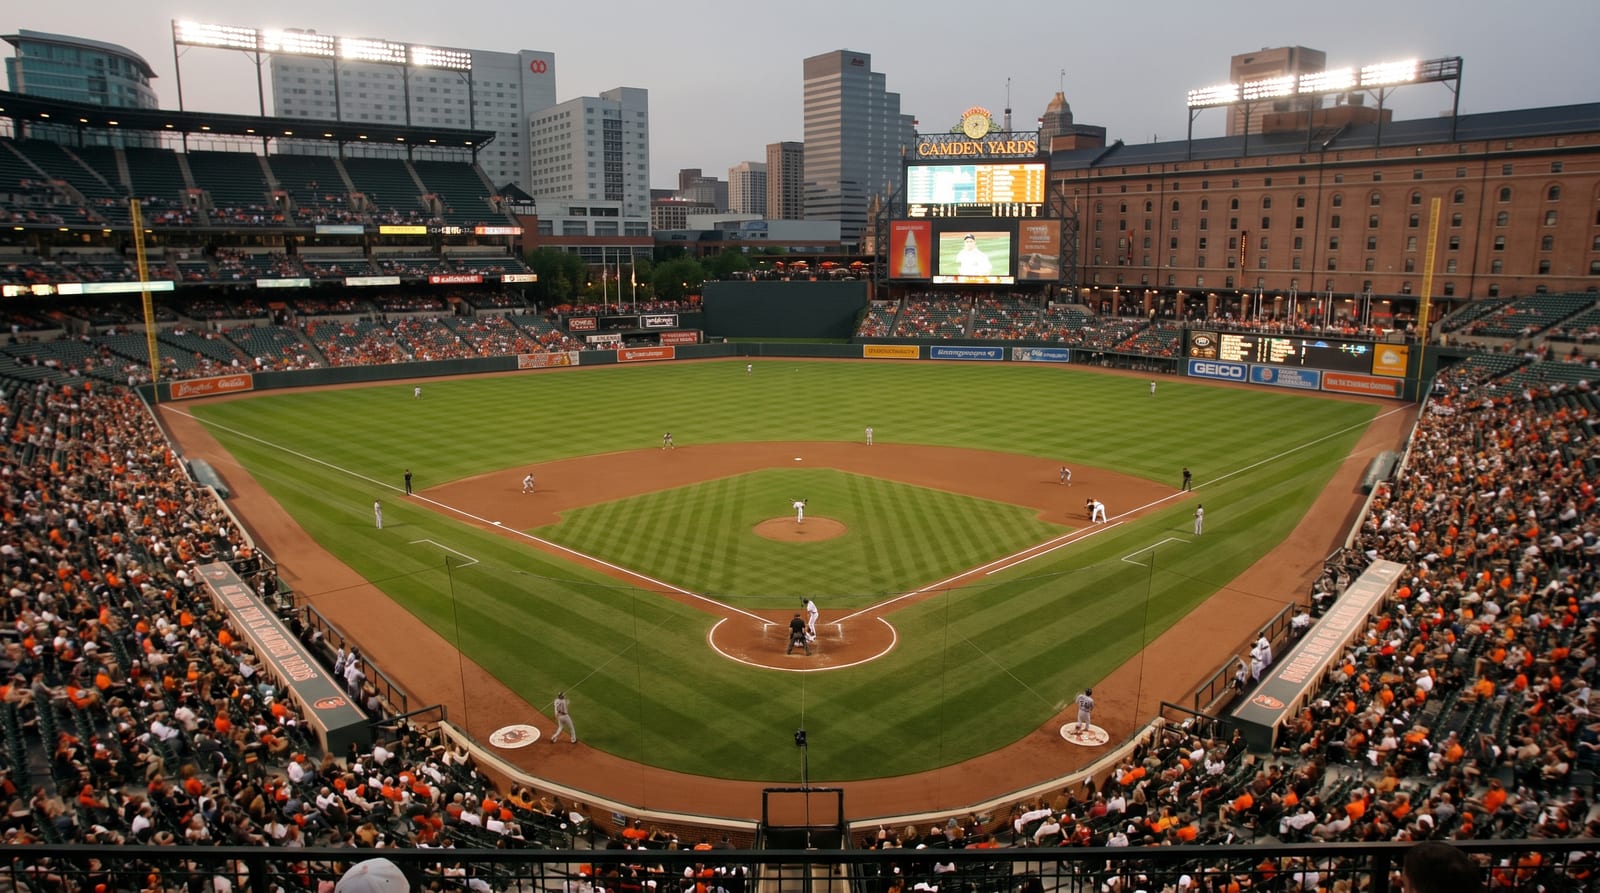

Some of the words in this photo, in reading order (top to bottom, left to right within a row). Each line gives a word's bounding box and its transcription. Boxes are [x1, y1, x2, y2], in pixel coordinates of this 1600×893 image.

[918, 141, 984, 156] CAMDEN
[987, 140, 1037, 155] YARDS
[1194, 362, 1242, 377] GEICO
